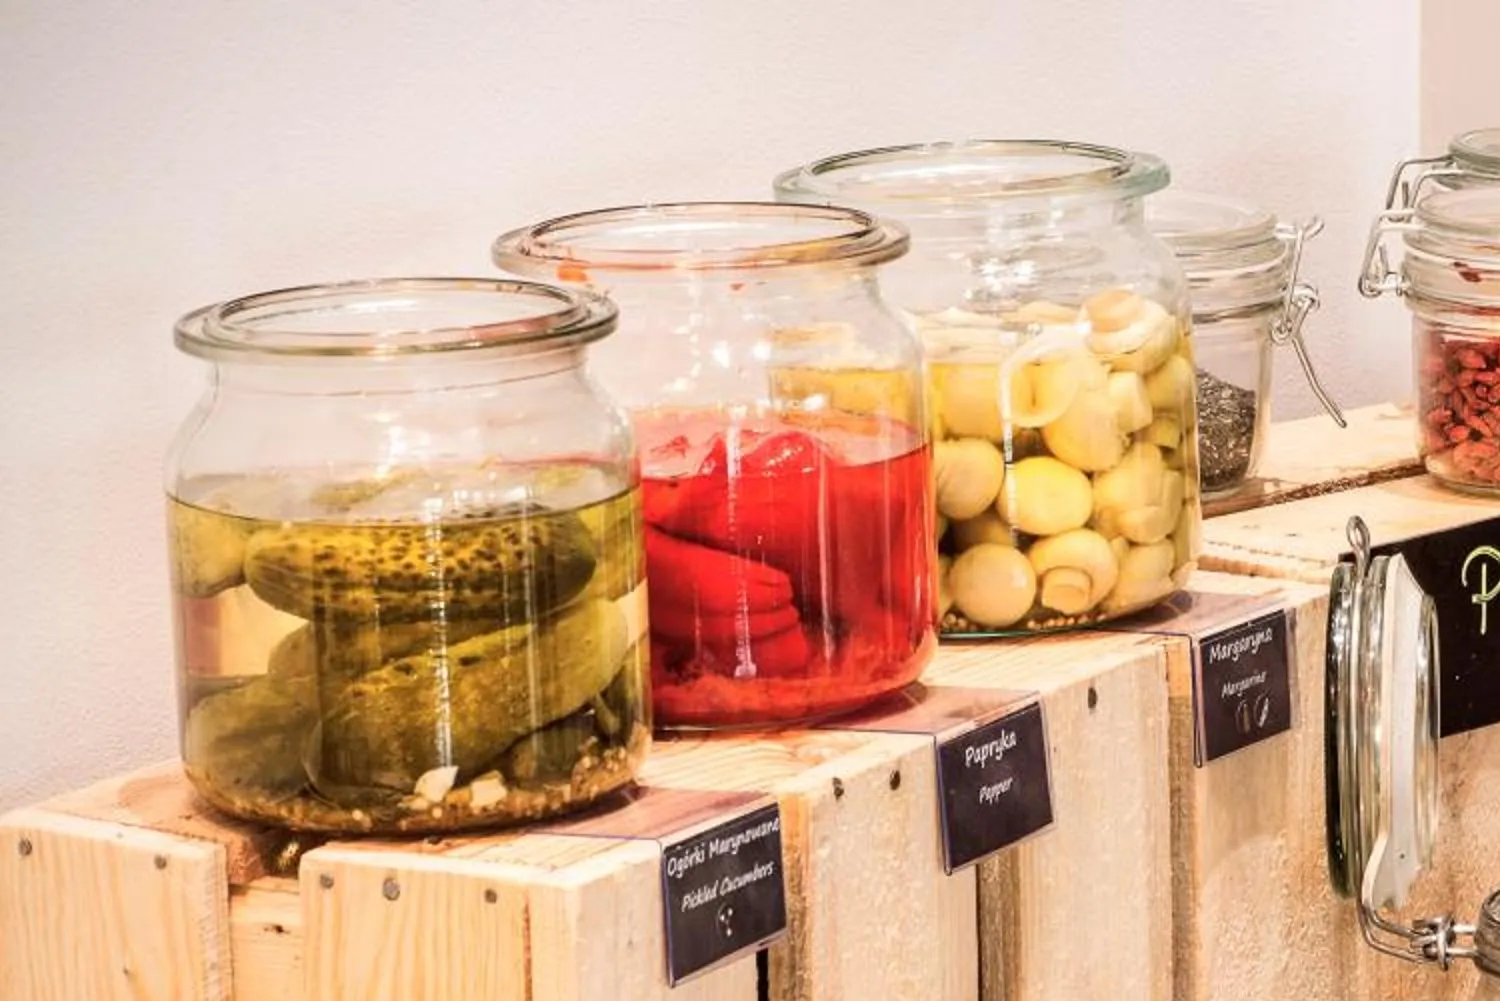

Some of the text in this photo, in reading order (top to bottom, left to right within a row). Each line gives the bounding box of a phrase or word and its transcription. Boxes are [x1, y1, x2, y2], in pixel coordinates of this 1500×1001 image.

[1208, 627, 1273, 665] Margaryna
[964, 728, 1017, 769] Papryka
[978, 777, 1014, 805] Pepper
[681, 860, 775, 913] Pickled Cucumbers
